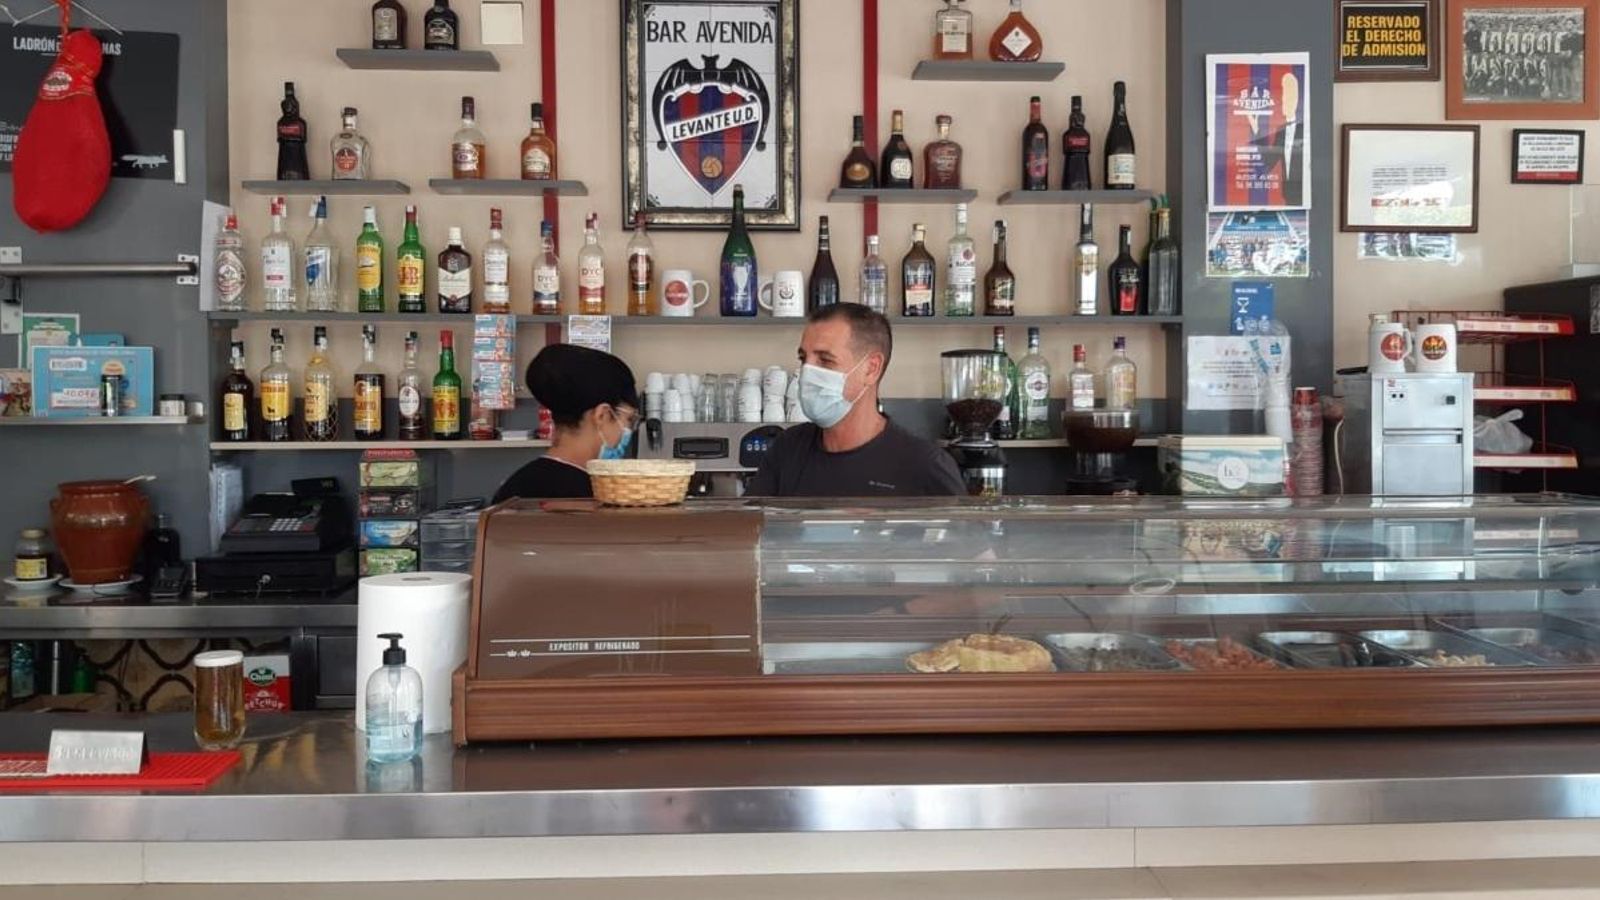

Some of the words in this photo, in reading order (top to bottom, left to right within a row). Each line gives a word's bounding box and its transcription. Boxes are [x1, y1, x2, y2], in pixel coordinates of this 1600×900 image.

[1347, 15, 1420, 28] RESERVADO
[647, 20, 688, 43] BAR
[696, 20, 773, 43] AVENIDA
[1346, 30, 1361, 42] EL
[1365, 30, 1421, 42] DERECHO
[13, 36, 55, 52] LADRÓN
[1342, 43, 1358, 57] DE
[1362, 43, 1426, 57] ADMISION
[1240, 86, 1271, 99] BAR
[1233, 98, 1276, 110] AVENIDA
[672, 111, 730, 139] LEVANTE
[732, 107, 757, 124] U.D.
[582, 267, 601, 276] DYC
[549, 642, 588, 651] EXPOSITOR
[594, 641, 640, 650] REFRIGERADO
